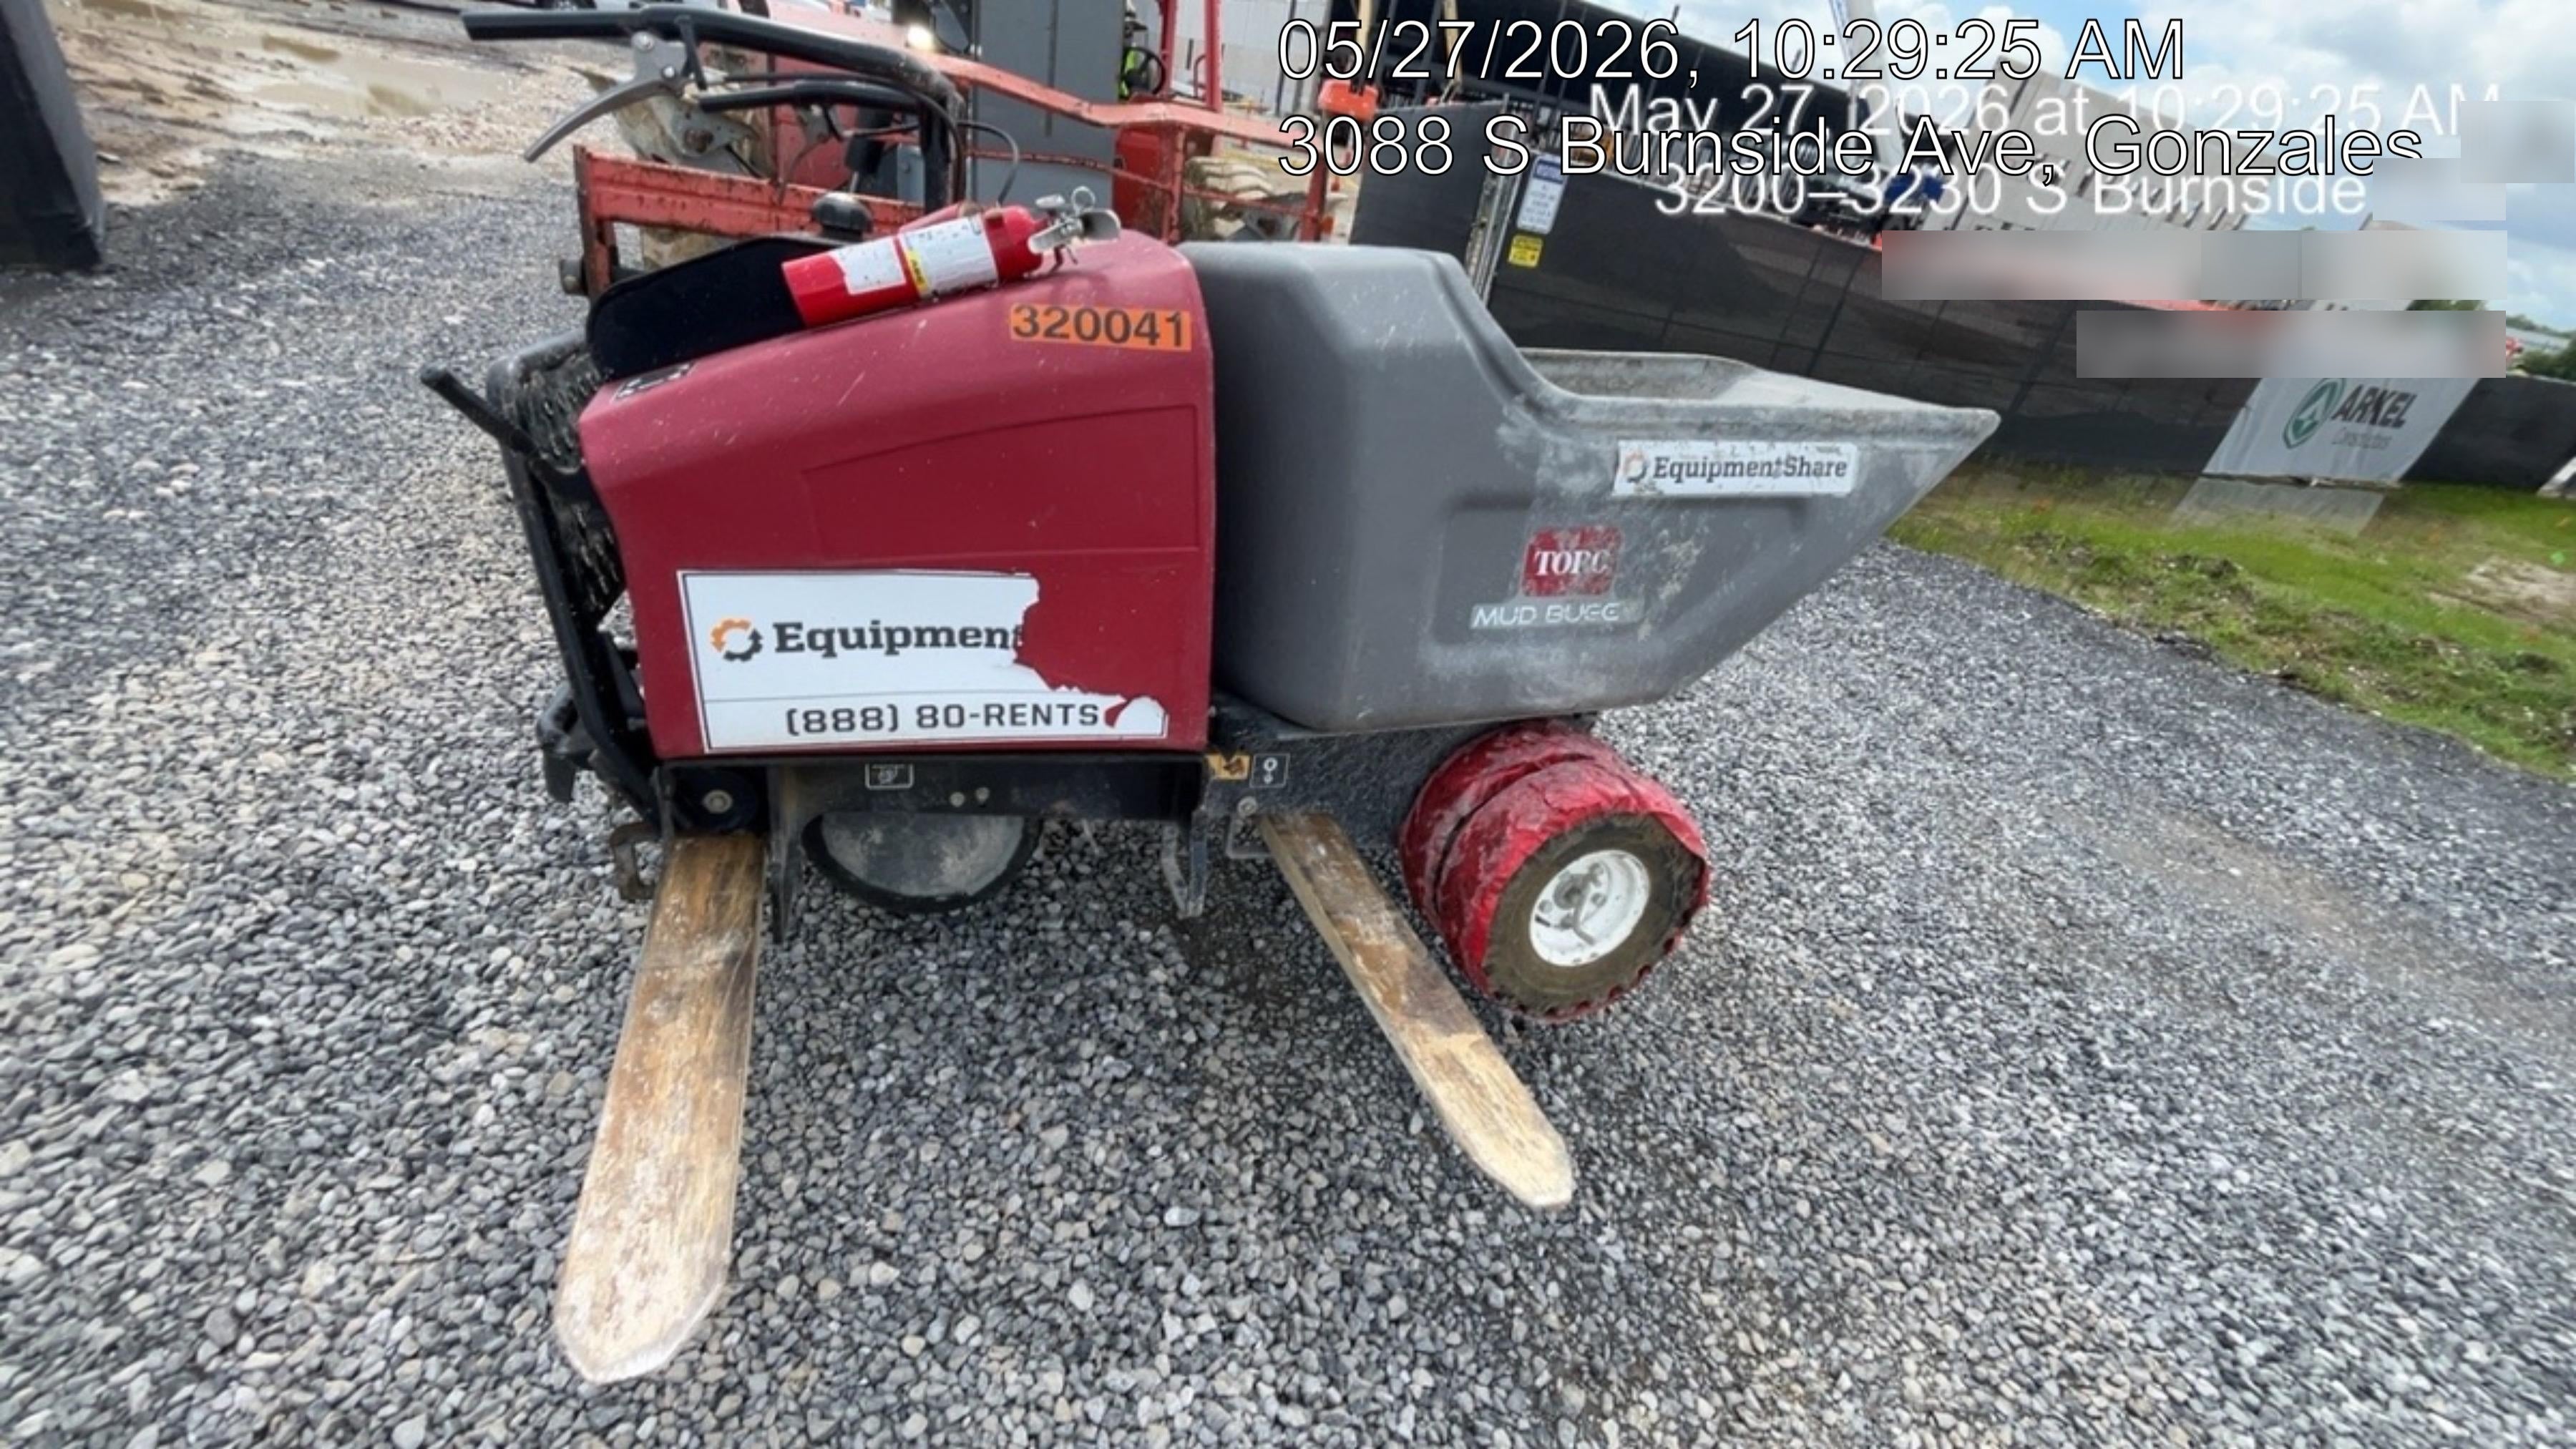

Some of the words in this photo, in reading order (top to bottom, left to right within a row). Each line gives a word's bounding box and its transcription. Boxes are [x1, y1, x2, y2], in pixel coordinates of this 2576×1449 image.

[1012, 303, 1186, 347] 320041
[2331, 384, 2417, 428] ARKEL
[1653, 455, 1848, 483] EquipmentShare
[1473, 605, 1537, 627] MUD
[786, 705, 899, 736] (888)
[917, 703, 1099, 728] 80-RENTS
